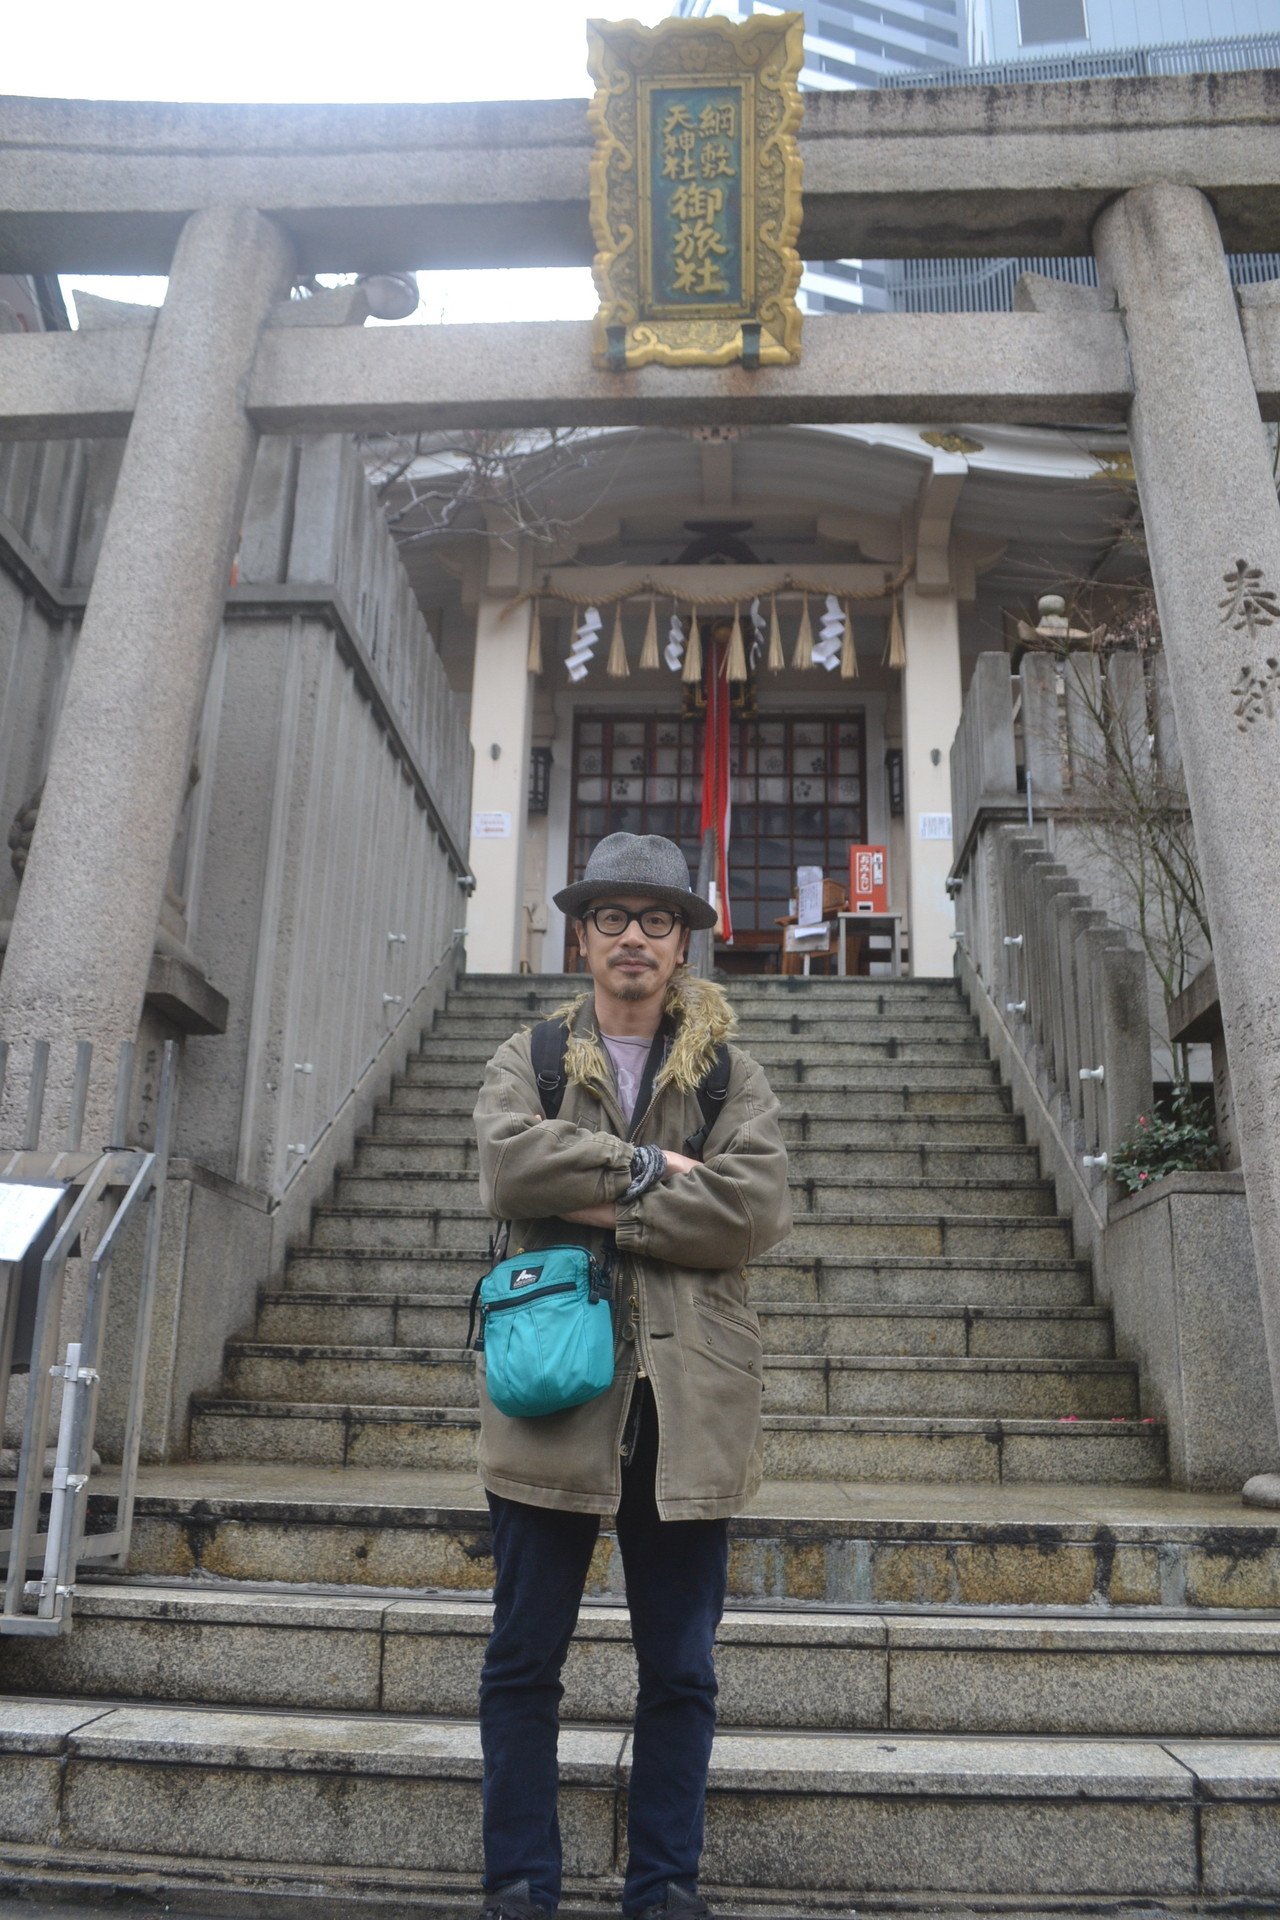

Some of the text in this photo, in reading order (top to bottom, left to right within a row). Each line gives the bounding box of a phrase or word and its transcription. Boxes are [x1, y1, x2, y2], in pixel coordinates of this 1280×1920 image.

[662, 104, 698, 182] 天神社
[671, 184, 731, 295] 御旅社
